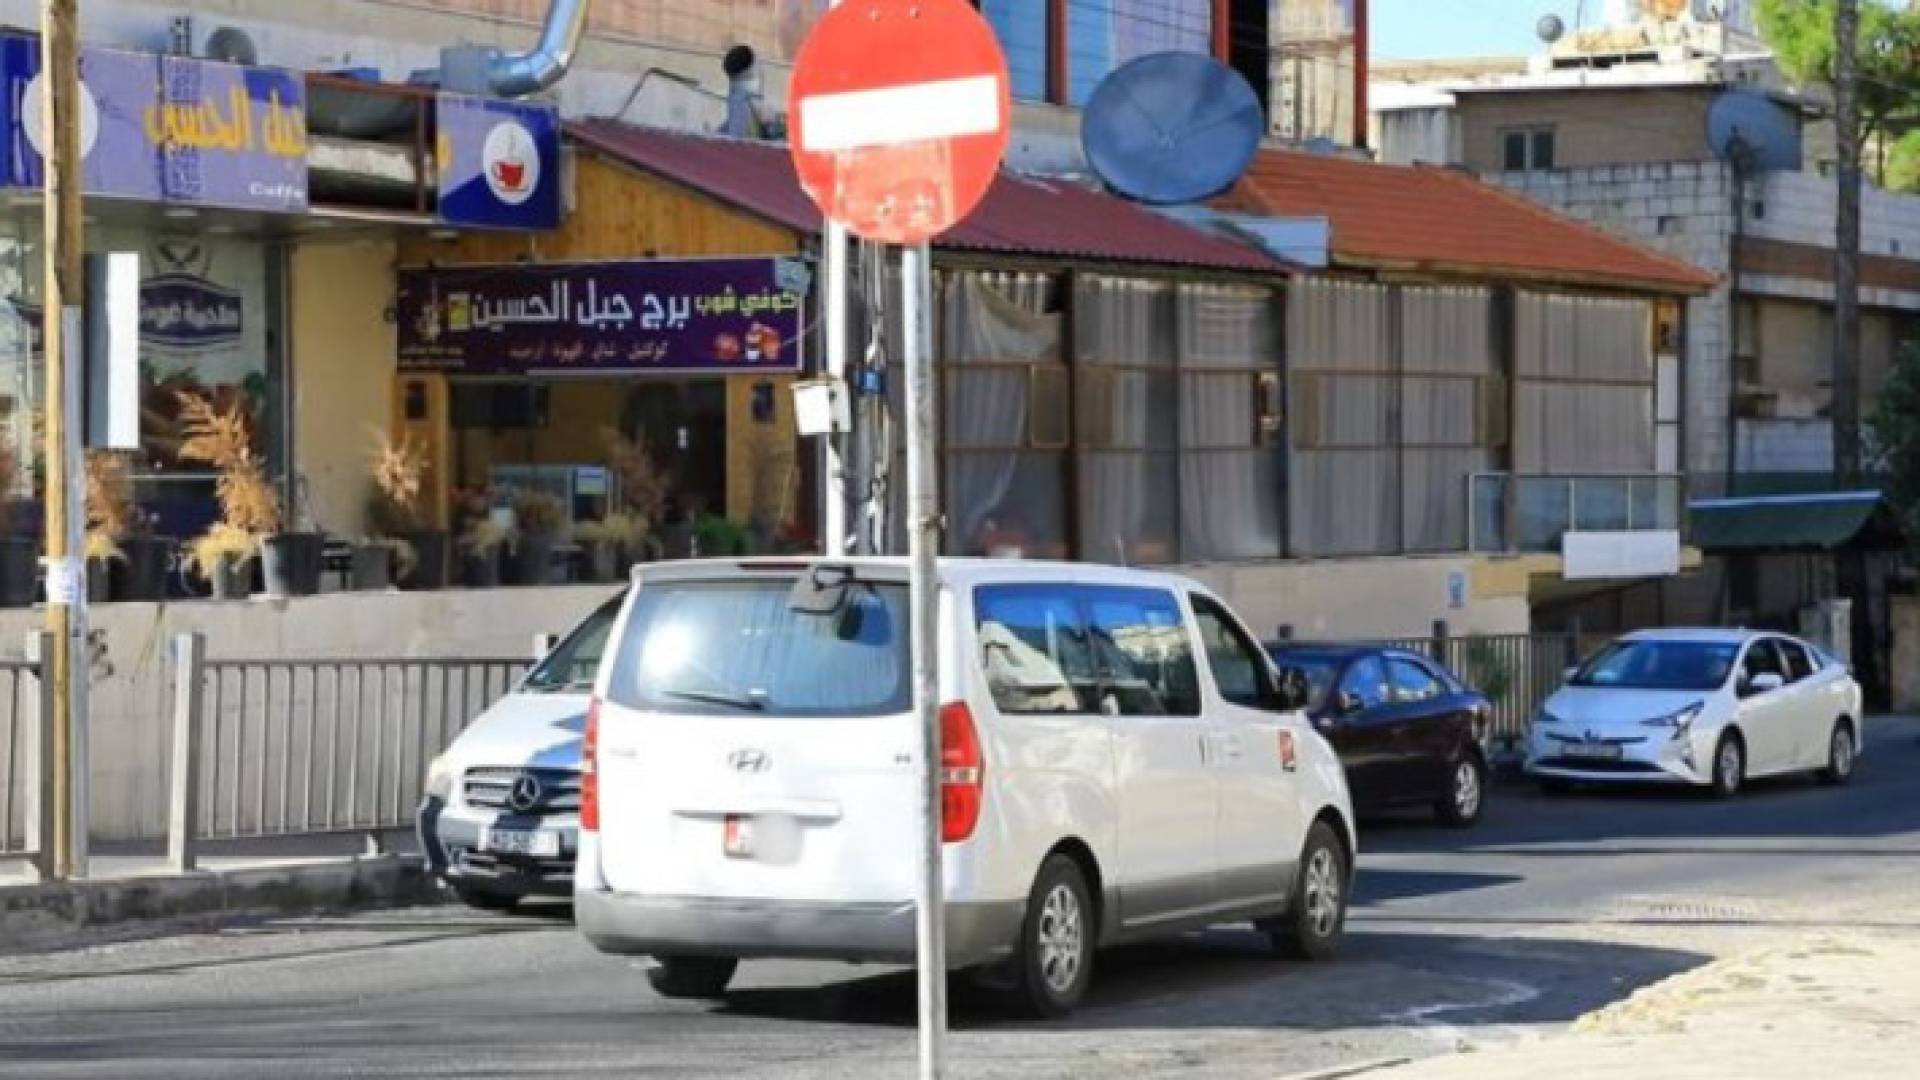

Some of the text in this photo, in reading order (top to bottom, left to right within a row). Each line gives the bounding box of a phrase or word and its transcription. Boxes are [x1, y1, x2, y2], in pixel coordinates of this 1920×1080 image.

[472, 280, 570, 332] الحسين
[577, 279, 633, 329] جبل
[640, 290, 690, 330] برج
